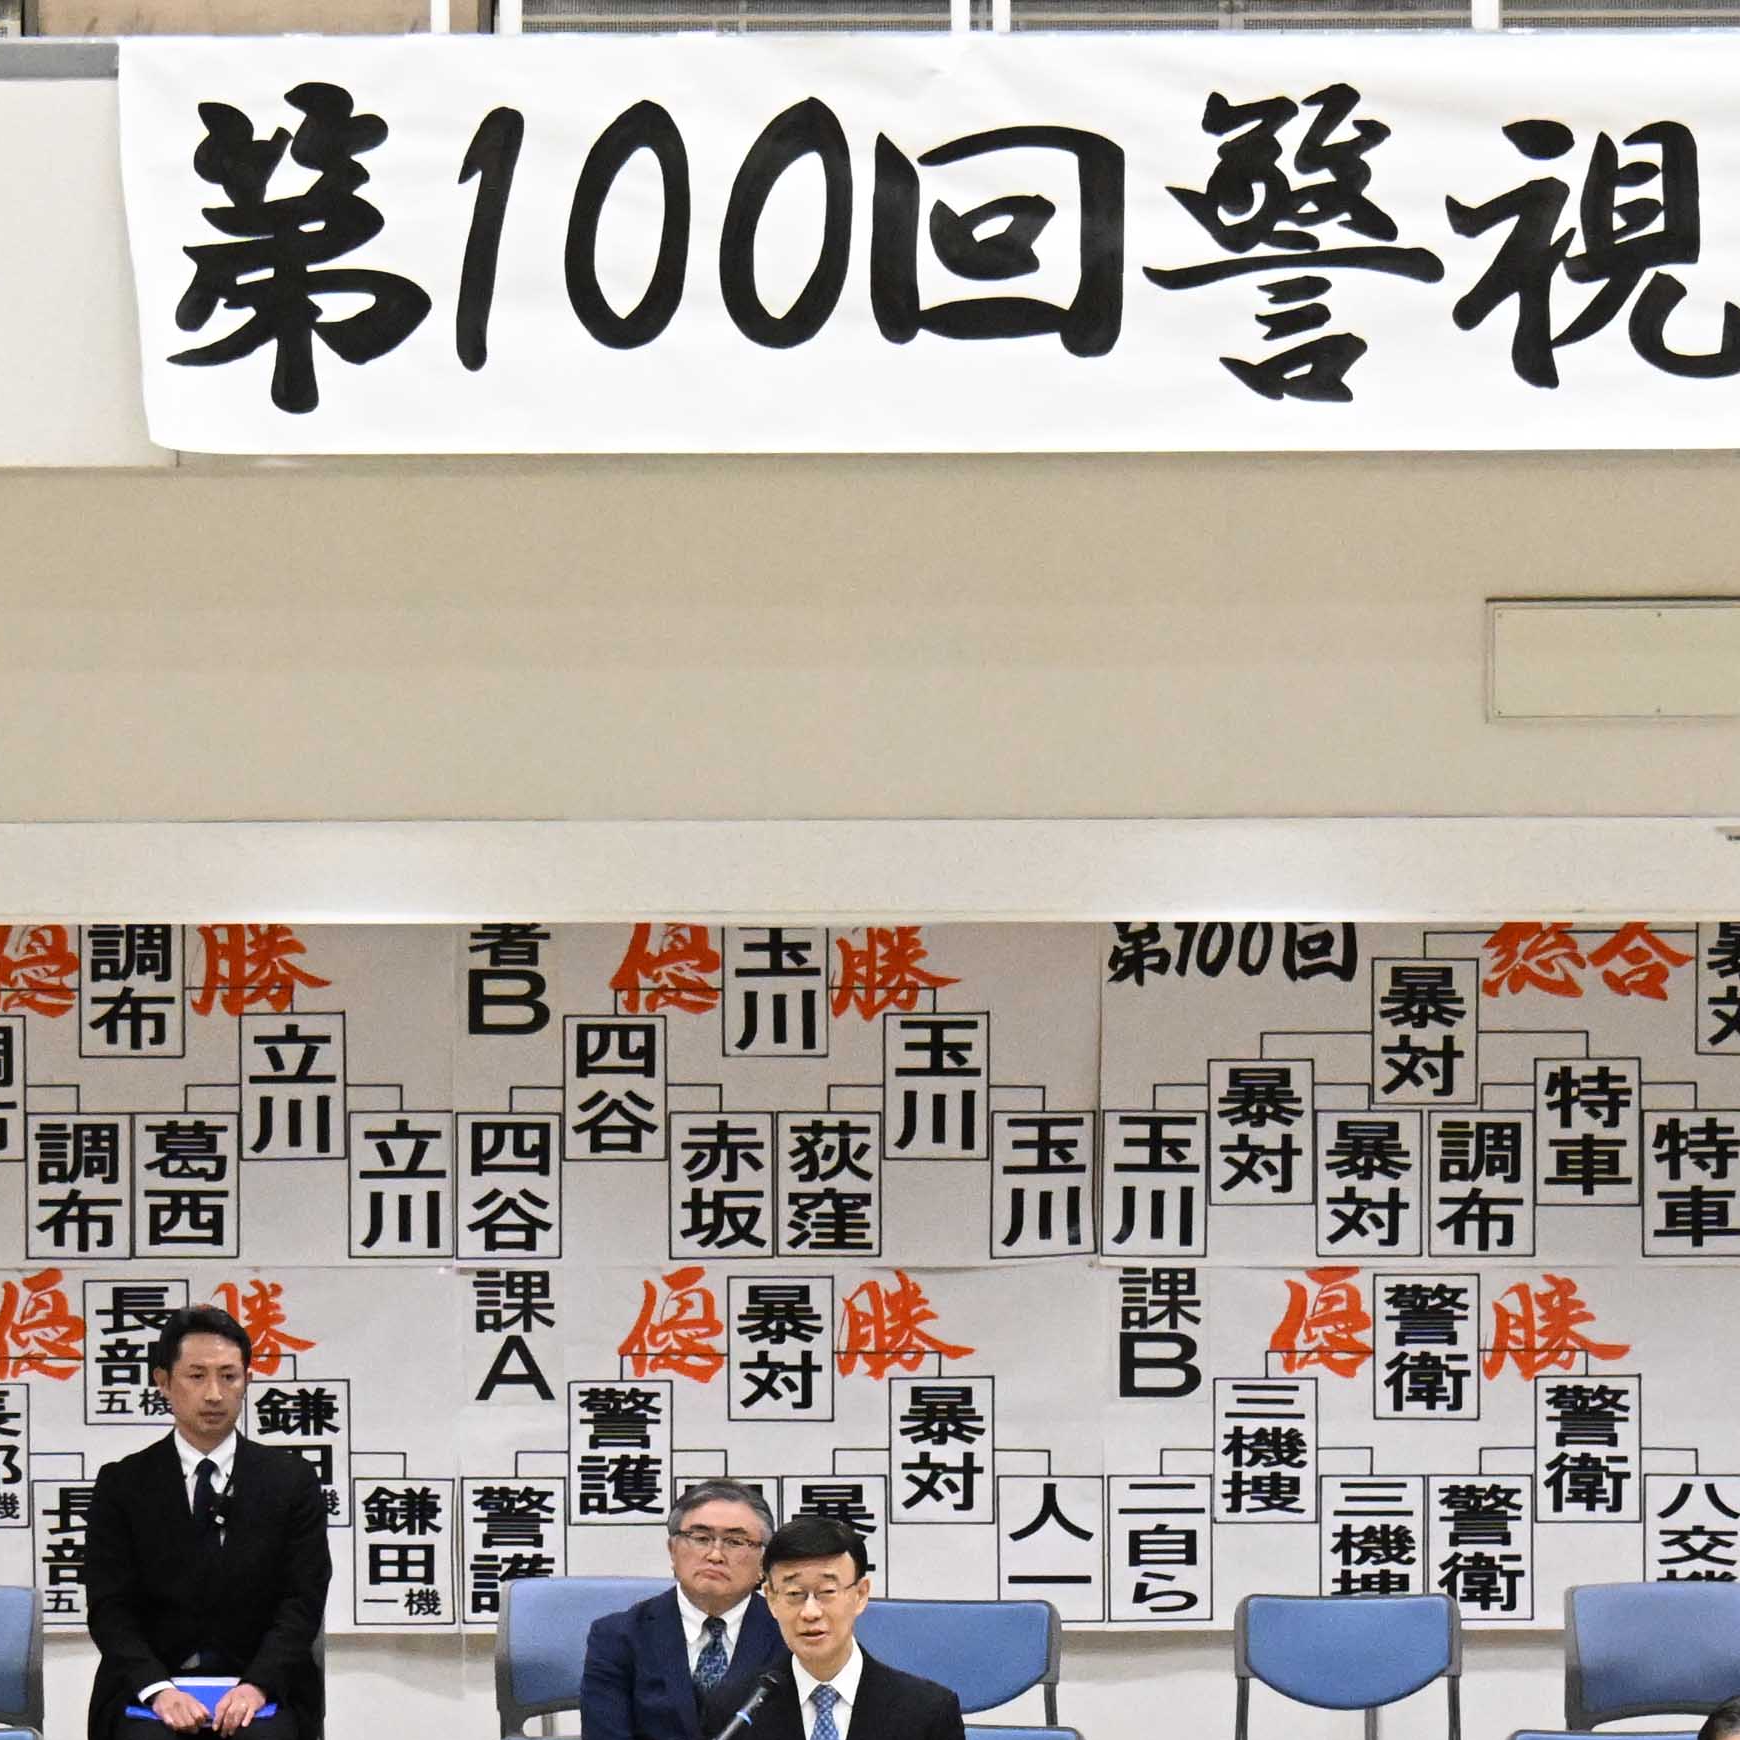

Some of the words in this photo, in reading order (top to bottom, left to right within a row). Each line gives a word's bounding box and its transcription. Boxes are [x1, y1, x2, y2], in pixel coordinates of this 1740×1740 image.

[87, 925, 176, 1051] 調布
[467, 923, 551, 1036] 者B
[734, 926, 822, 1051] 玉川
[1107, 922, 1358, 987] 第100回
[1481, 923, 1694, 1001] 総合
[248, 1023, 337, 1154] 立川
[571, 1023, 659, 1154] 四谷
[893, 1020, 982, 1151] 玉川
[1379, 966, 1467, 1097] 暴対
[34, 1123, 123, 1253] 調布
[143, 1119, 229, 1246] 葛西
[359, 1119, 447, 1249] 立川
[467, 1121, 553, 1252] 四谷
[680, 1119, 767, 1249] 赤坂
[787, 1119, 874, 1250] 荻窪
[1001, 1116, 1087, 1247] 玉川
[1112, 1115, 1200, 1247] 玉川
[1217, 1067, 1305, 1194] 暴対
[1325, 1120, 1413, 1247] 暴対
[1436, 1120, 1524, 1252] 調布
[1544, 1065, 1633, 1196] 特車
[472, 1269, 556, 1401] 課A
[617, 1264, 725, 1384] 優
[835, 1268, 976, 1381] 勝
[736, 1284, 824, 1410] 暴対
[1118, 1267, 1202, 1398] 課B
[1268, 1264, 1374, 1379] 優
[1482, 1272, 1631, 1381] 勝
[1383, 1283, 1472, 1412] 警衛
[577, 1387, 664, 1515] 警護
[899, 1386, 986, 1511] 暴対
[1221, 1384, 1307, 1514] 三機捜
[1543, 1384, 1631, 1513] 警衛
[362, 1486, 442, 1586] 鎌田
[792, 1484, 877, 1571] 暴
[1118, 1483, 1206, 1613] 二自ら
[1437, 1483, 1525, 1612] 警衛
[363, 1588, 442, 1616] 一機
